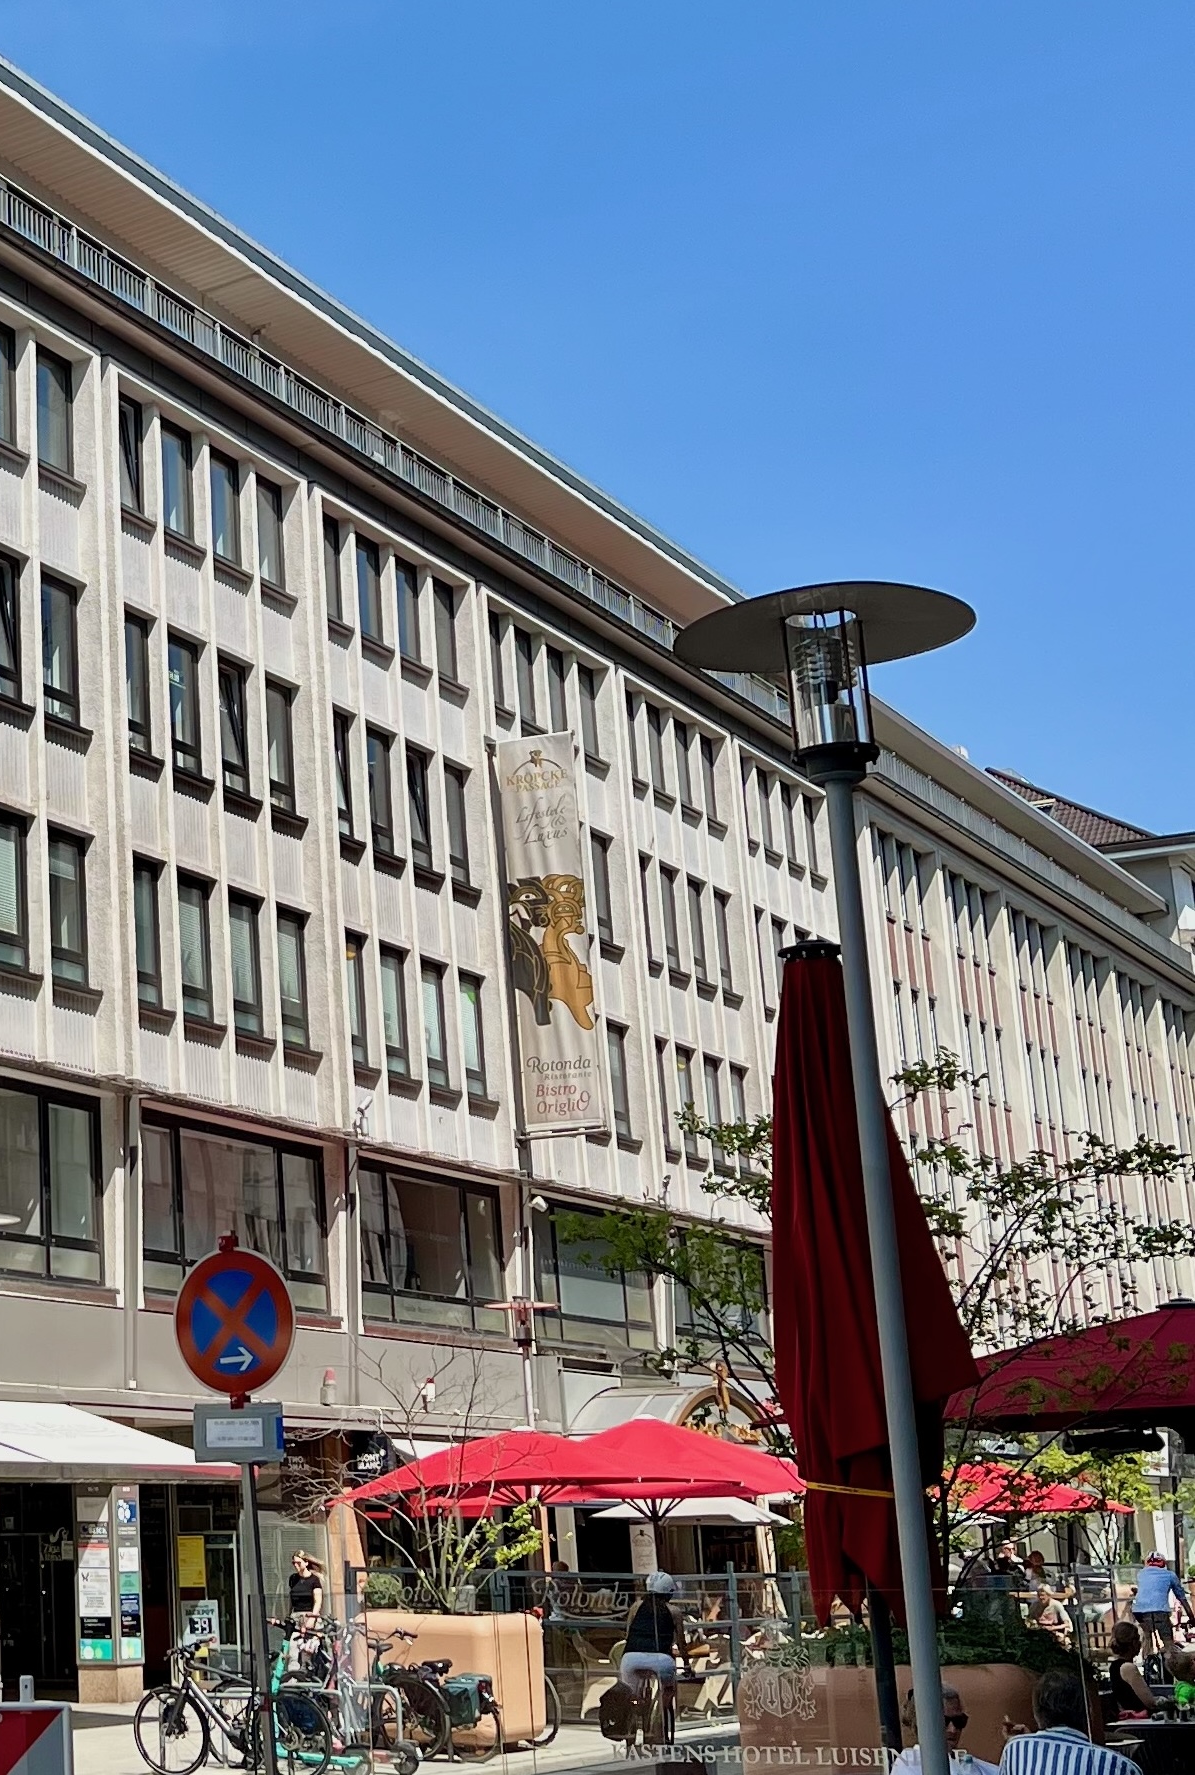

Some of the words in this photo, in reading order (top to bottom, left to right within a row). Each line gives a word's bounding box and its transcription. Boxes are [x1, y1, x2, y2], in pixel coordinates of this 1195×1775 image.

[515, 781, 560, 793] PASSAGE
[526, 1055, 591, 1074] Rotonda
[543, 1071, 592, 1081] Ristorante
[536, 1084, 577, 1098] Bistro
[194, 1618, 210, 1634] 39
[611, 1743, 717, 1765] KASTENS
[723, 1745, 803, 1766] HOTEL
[814, 1746, 968, 1768] LUISENF
